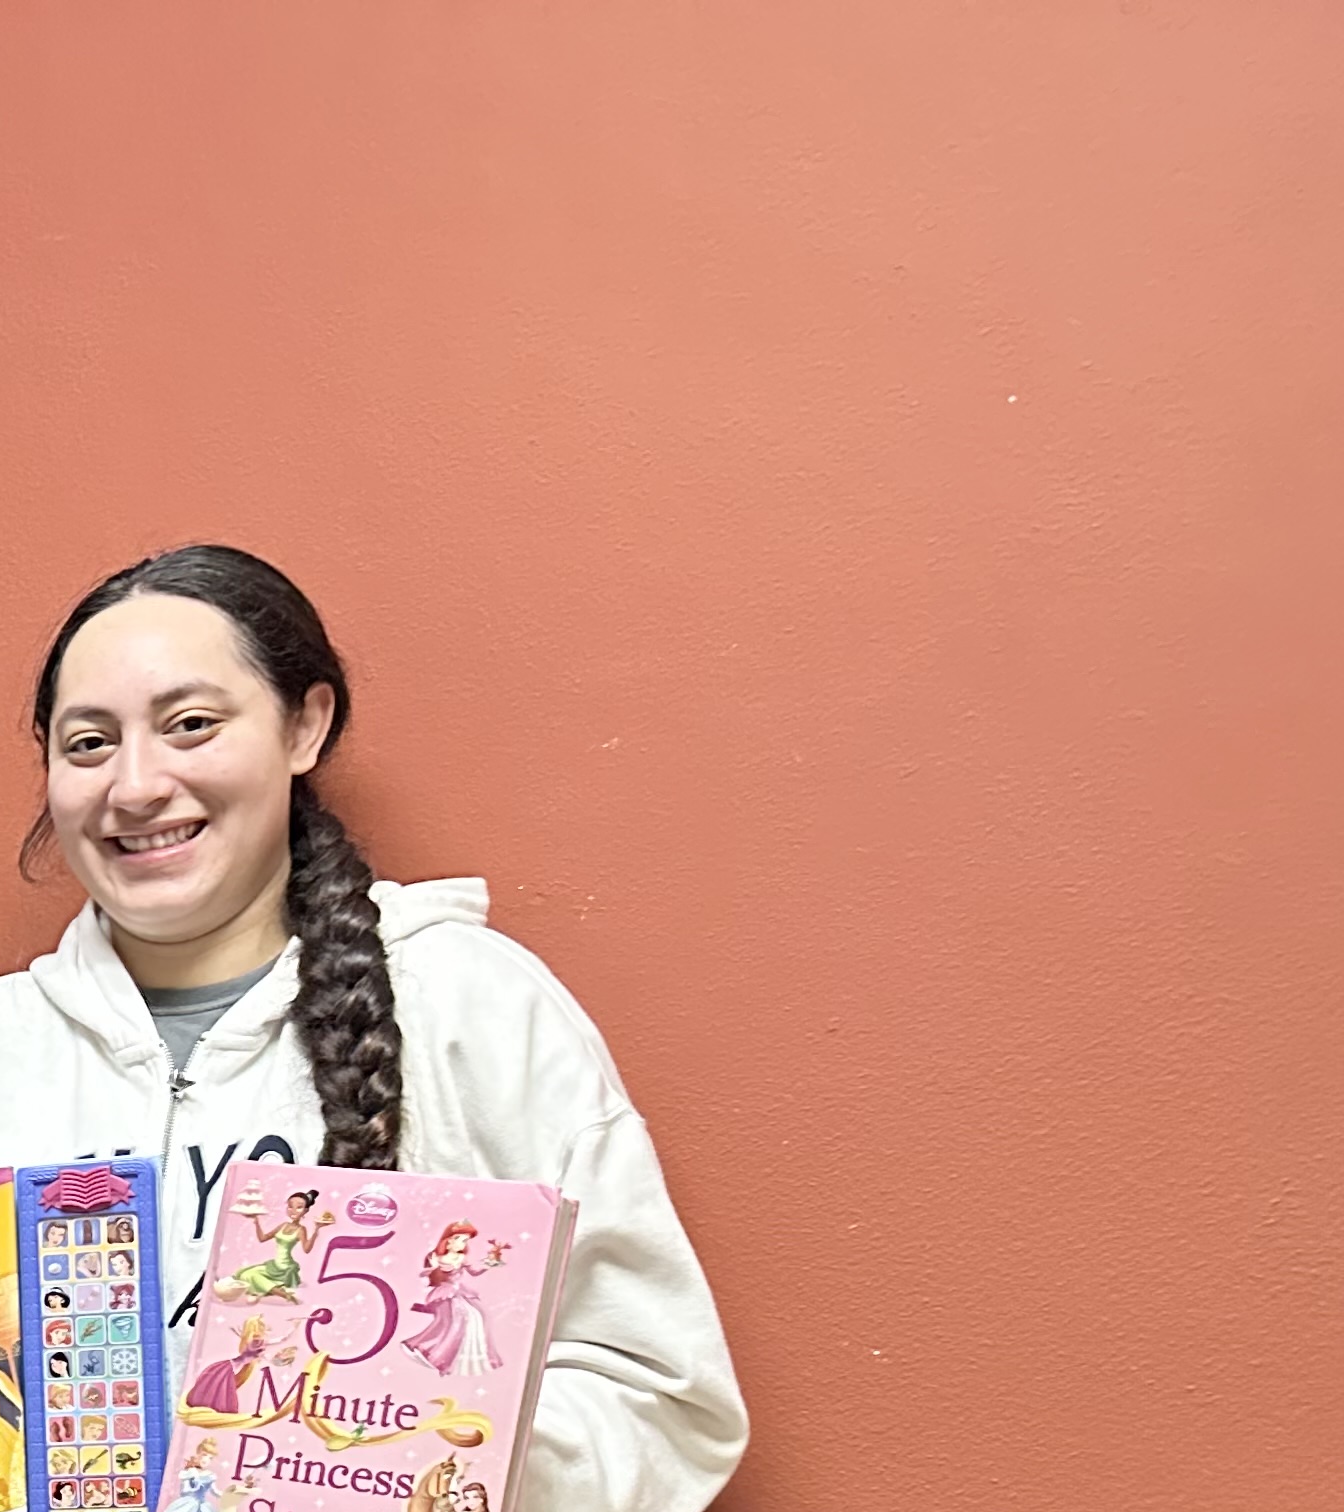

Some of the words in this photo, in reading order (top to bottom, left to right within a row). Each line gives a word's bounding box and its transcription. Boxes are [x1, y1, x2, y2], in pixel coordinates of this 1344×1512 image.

[352, 1201, 394, 1220] Disney
[304, 1231, 397, 1366] 5
[251, 1366, 419, 1430] Minute
[231, 1433, 415, 1499] Princess
